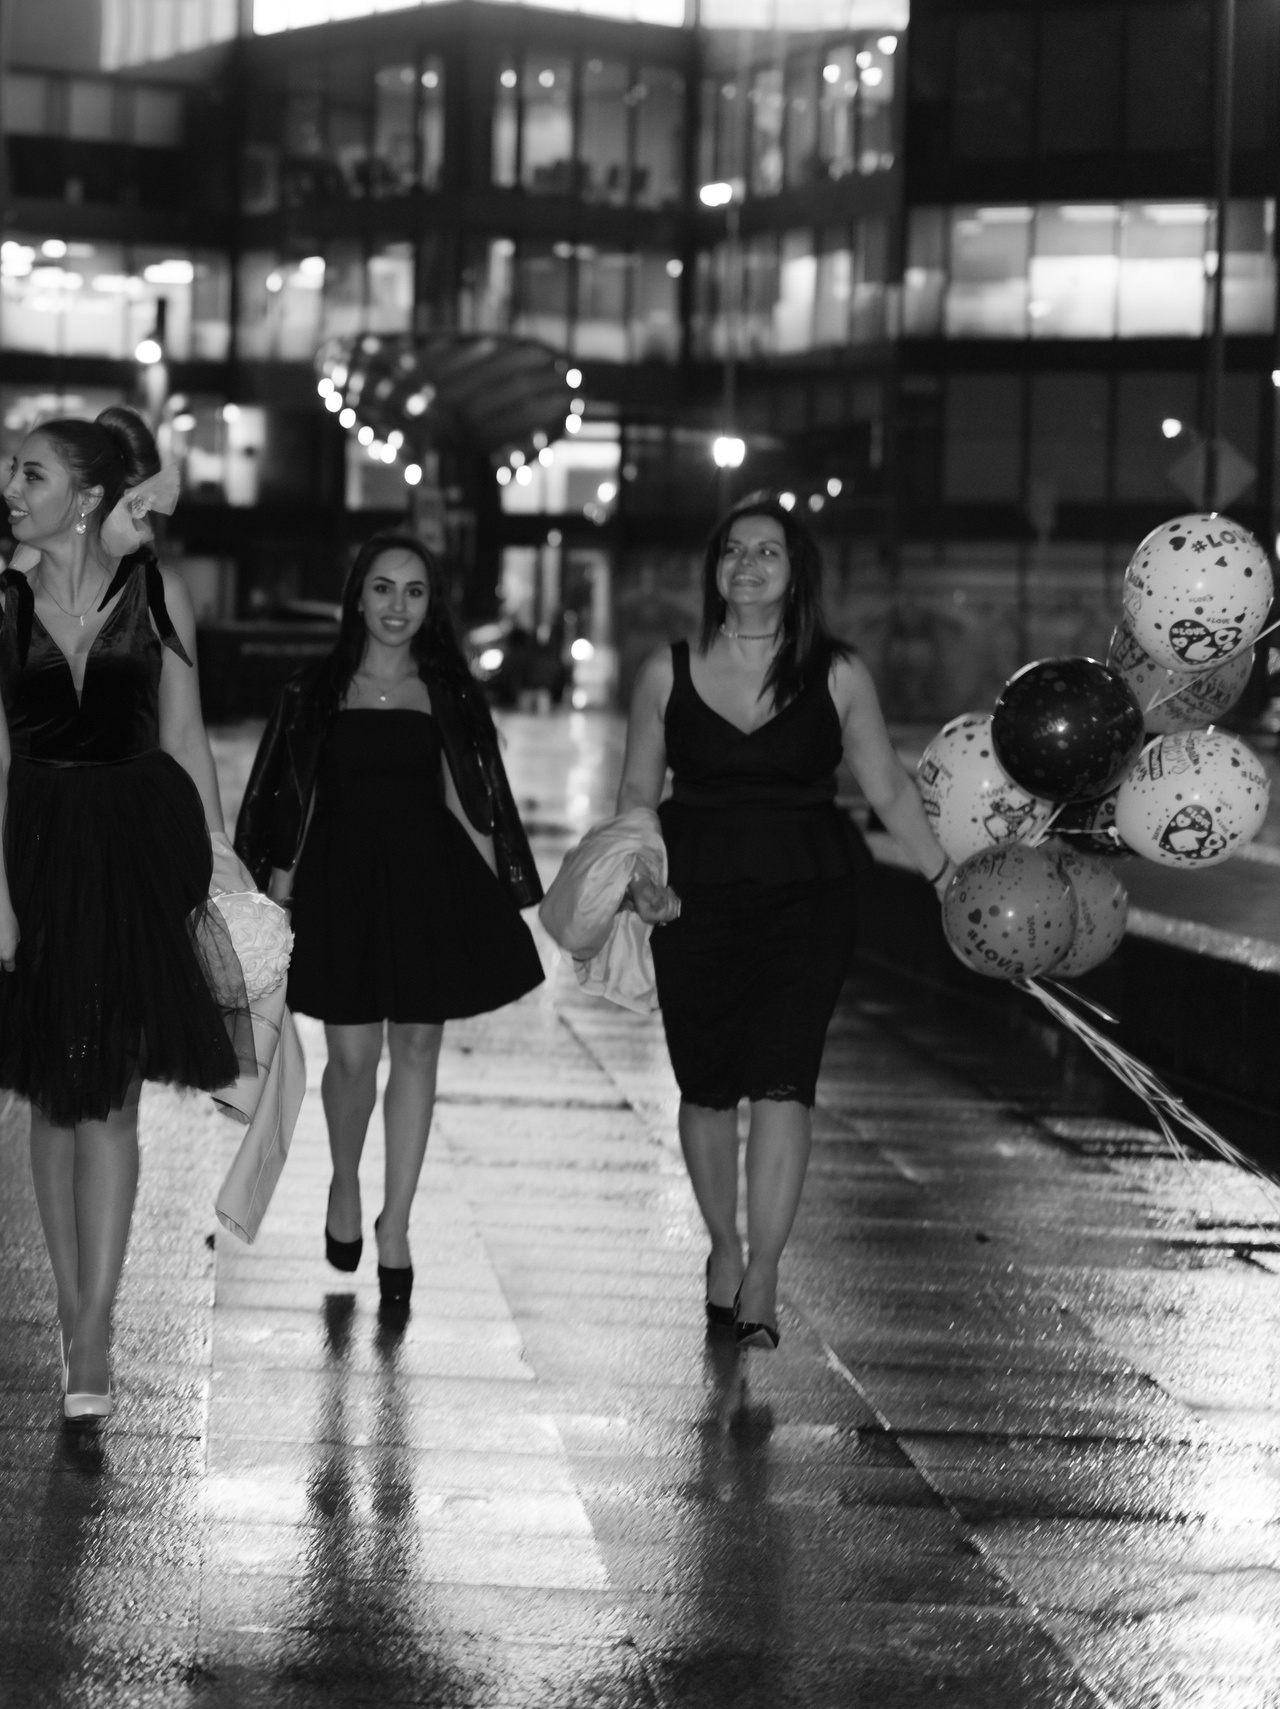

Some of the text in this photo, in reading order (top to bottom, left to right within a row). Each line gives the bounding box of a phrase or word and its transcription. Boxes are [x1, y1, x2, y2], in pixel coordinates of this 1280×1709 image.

[1172, 627, 1206, 636] #LOVE
[1186, 806, 1211, 829] #LOVE
[1026, 914, 1036, 949] #LOVE
